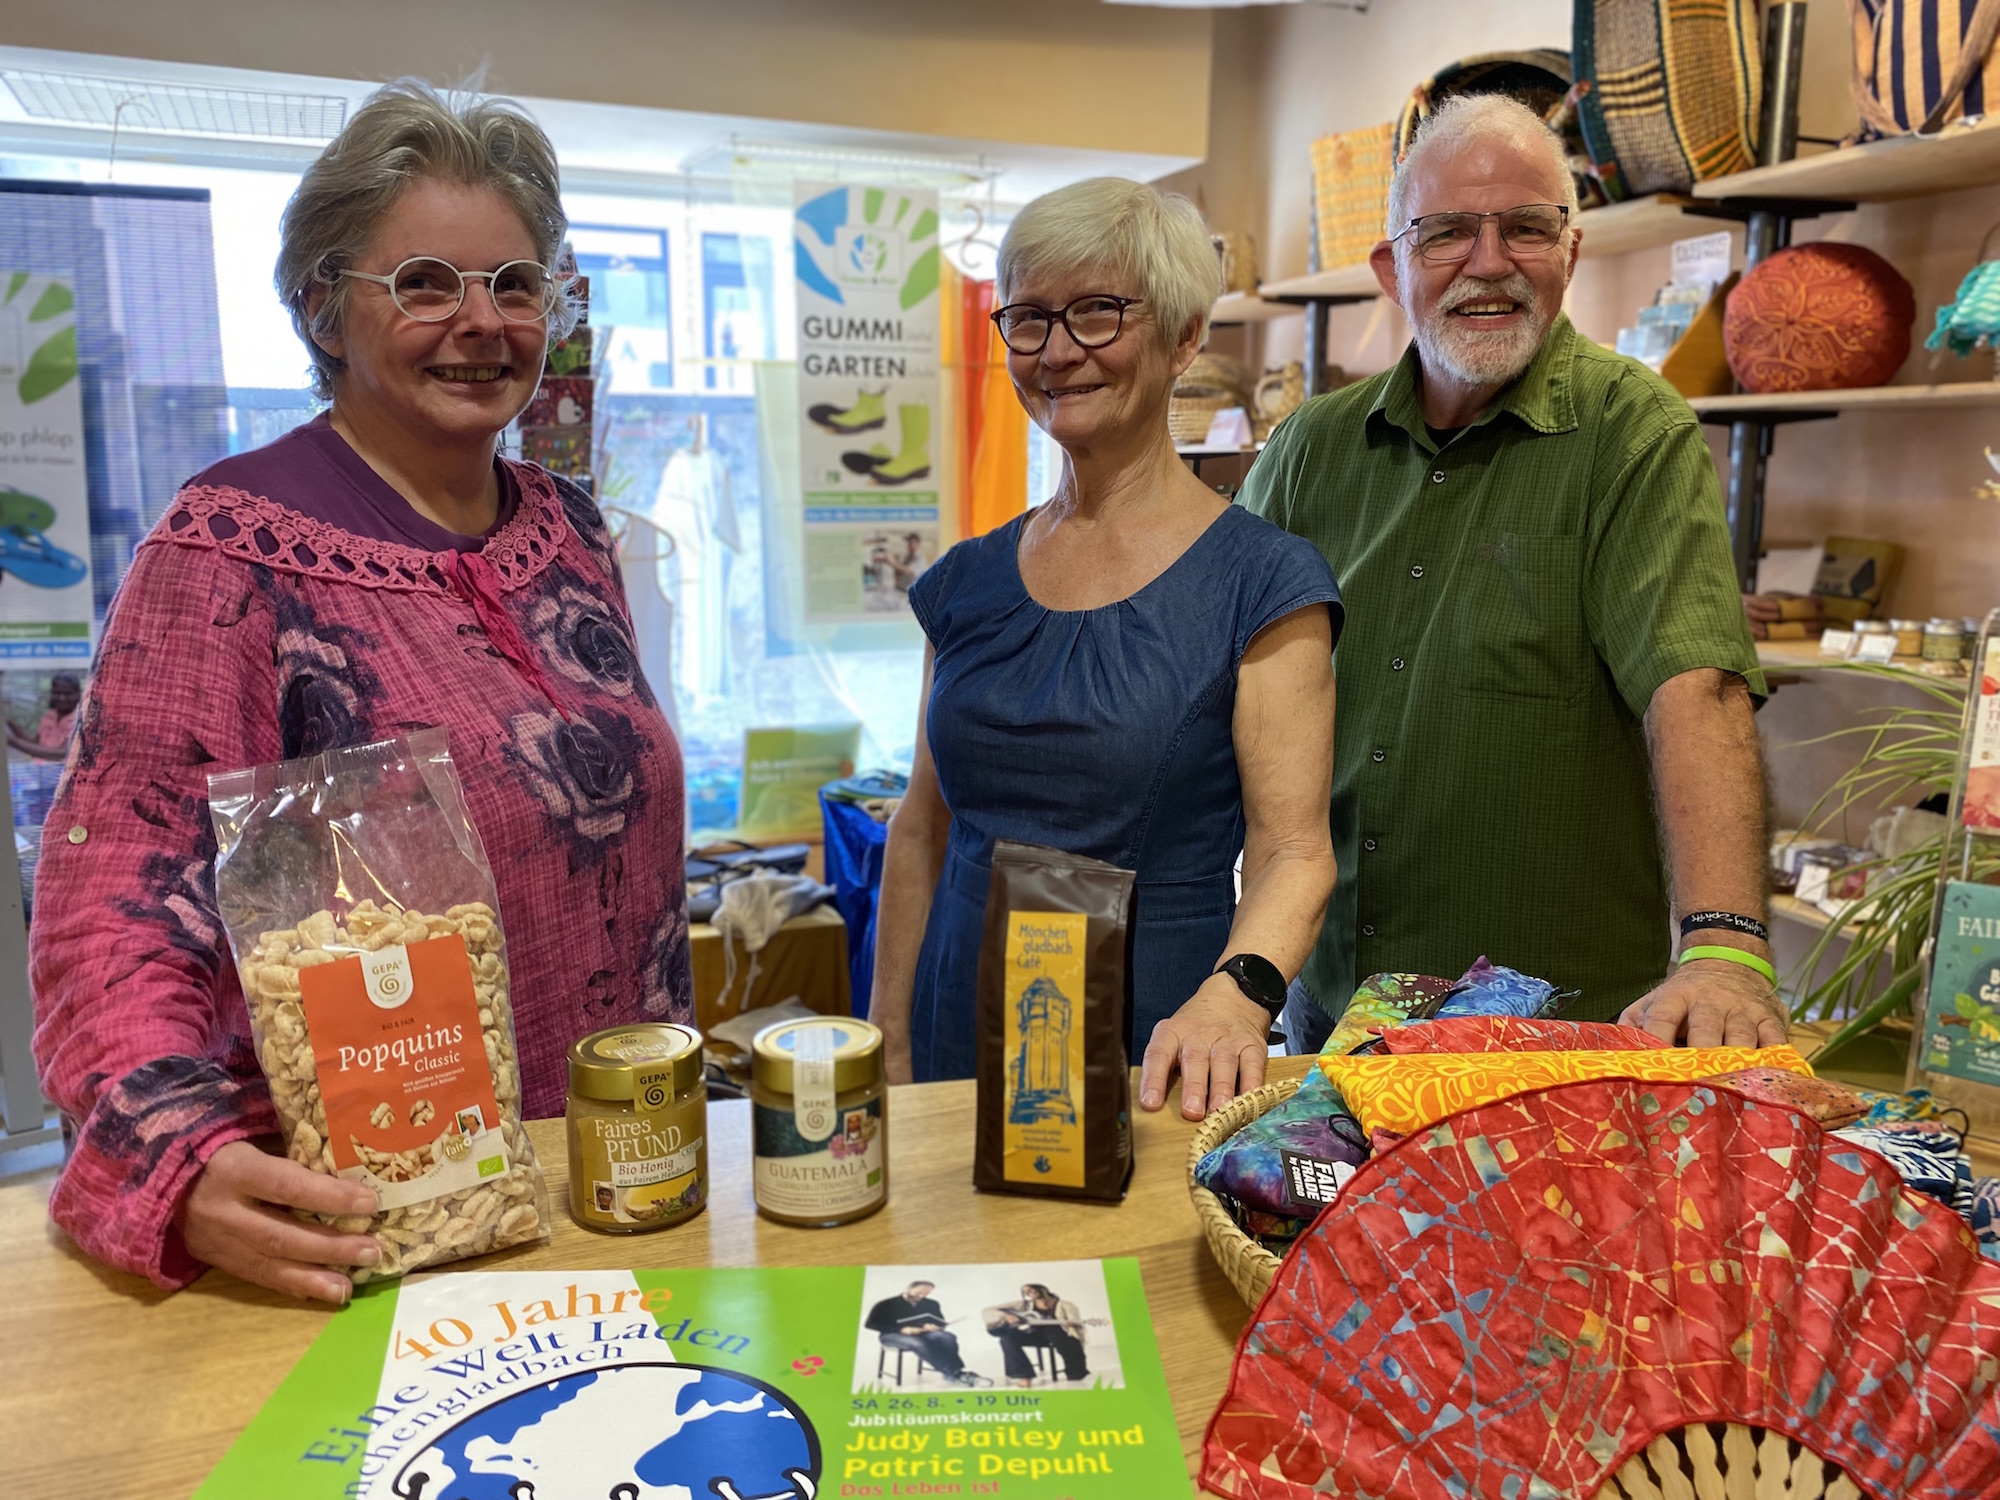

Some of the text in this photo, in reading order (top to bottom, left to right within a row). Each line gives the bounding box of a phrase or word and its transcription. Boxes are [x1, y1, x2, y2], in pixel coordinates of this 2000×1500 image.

[803, 315, 903, 342] GUMMI
[803, 353, 907, 378] GARTEN
[1019, 923, 1068, 939] Mönchen
[1023, 940, 1073, 955] gladbach
[1016, 953, 1041, 969] Café
[338, 1024, 463, 1073] Popquins
[414, 1051, 461, 1073] Classic
[594, 1118, 652, 1139] Faires
[604, 1125, 682, 1163] PFUND
[618, 1159, 674, 1176] Bio Honig
[768, 1158, 868, 1181] GUATEMALA
[1288, 1156, 1299, 1166] by
[633, 1175, 660, 1184] Fairem
[661, 1165, 685, 1179] Handel
[1300, 1159, 1320, 1201] TRADE
[394, 1283, 674, 1363] 40 Jahre
[297, 1318, 753, 1467] Eine Welt Laden
[851, 1394, 1043, 1411] SA 26. 8. 19 Uhr
[340, 1343, 625, 1500] nchengladbach
[847, 1409, 1045, 1428] Jubiläumskonzert
[844, 1424, 1146, 1454] Judy Bailey und
[843, 1451, 1114, 1481] Patric Depuhl
[840, 1480, 1000, 1498] Das Leben ist
